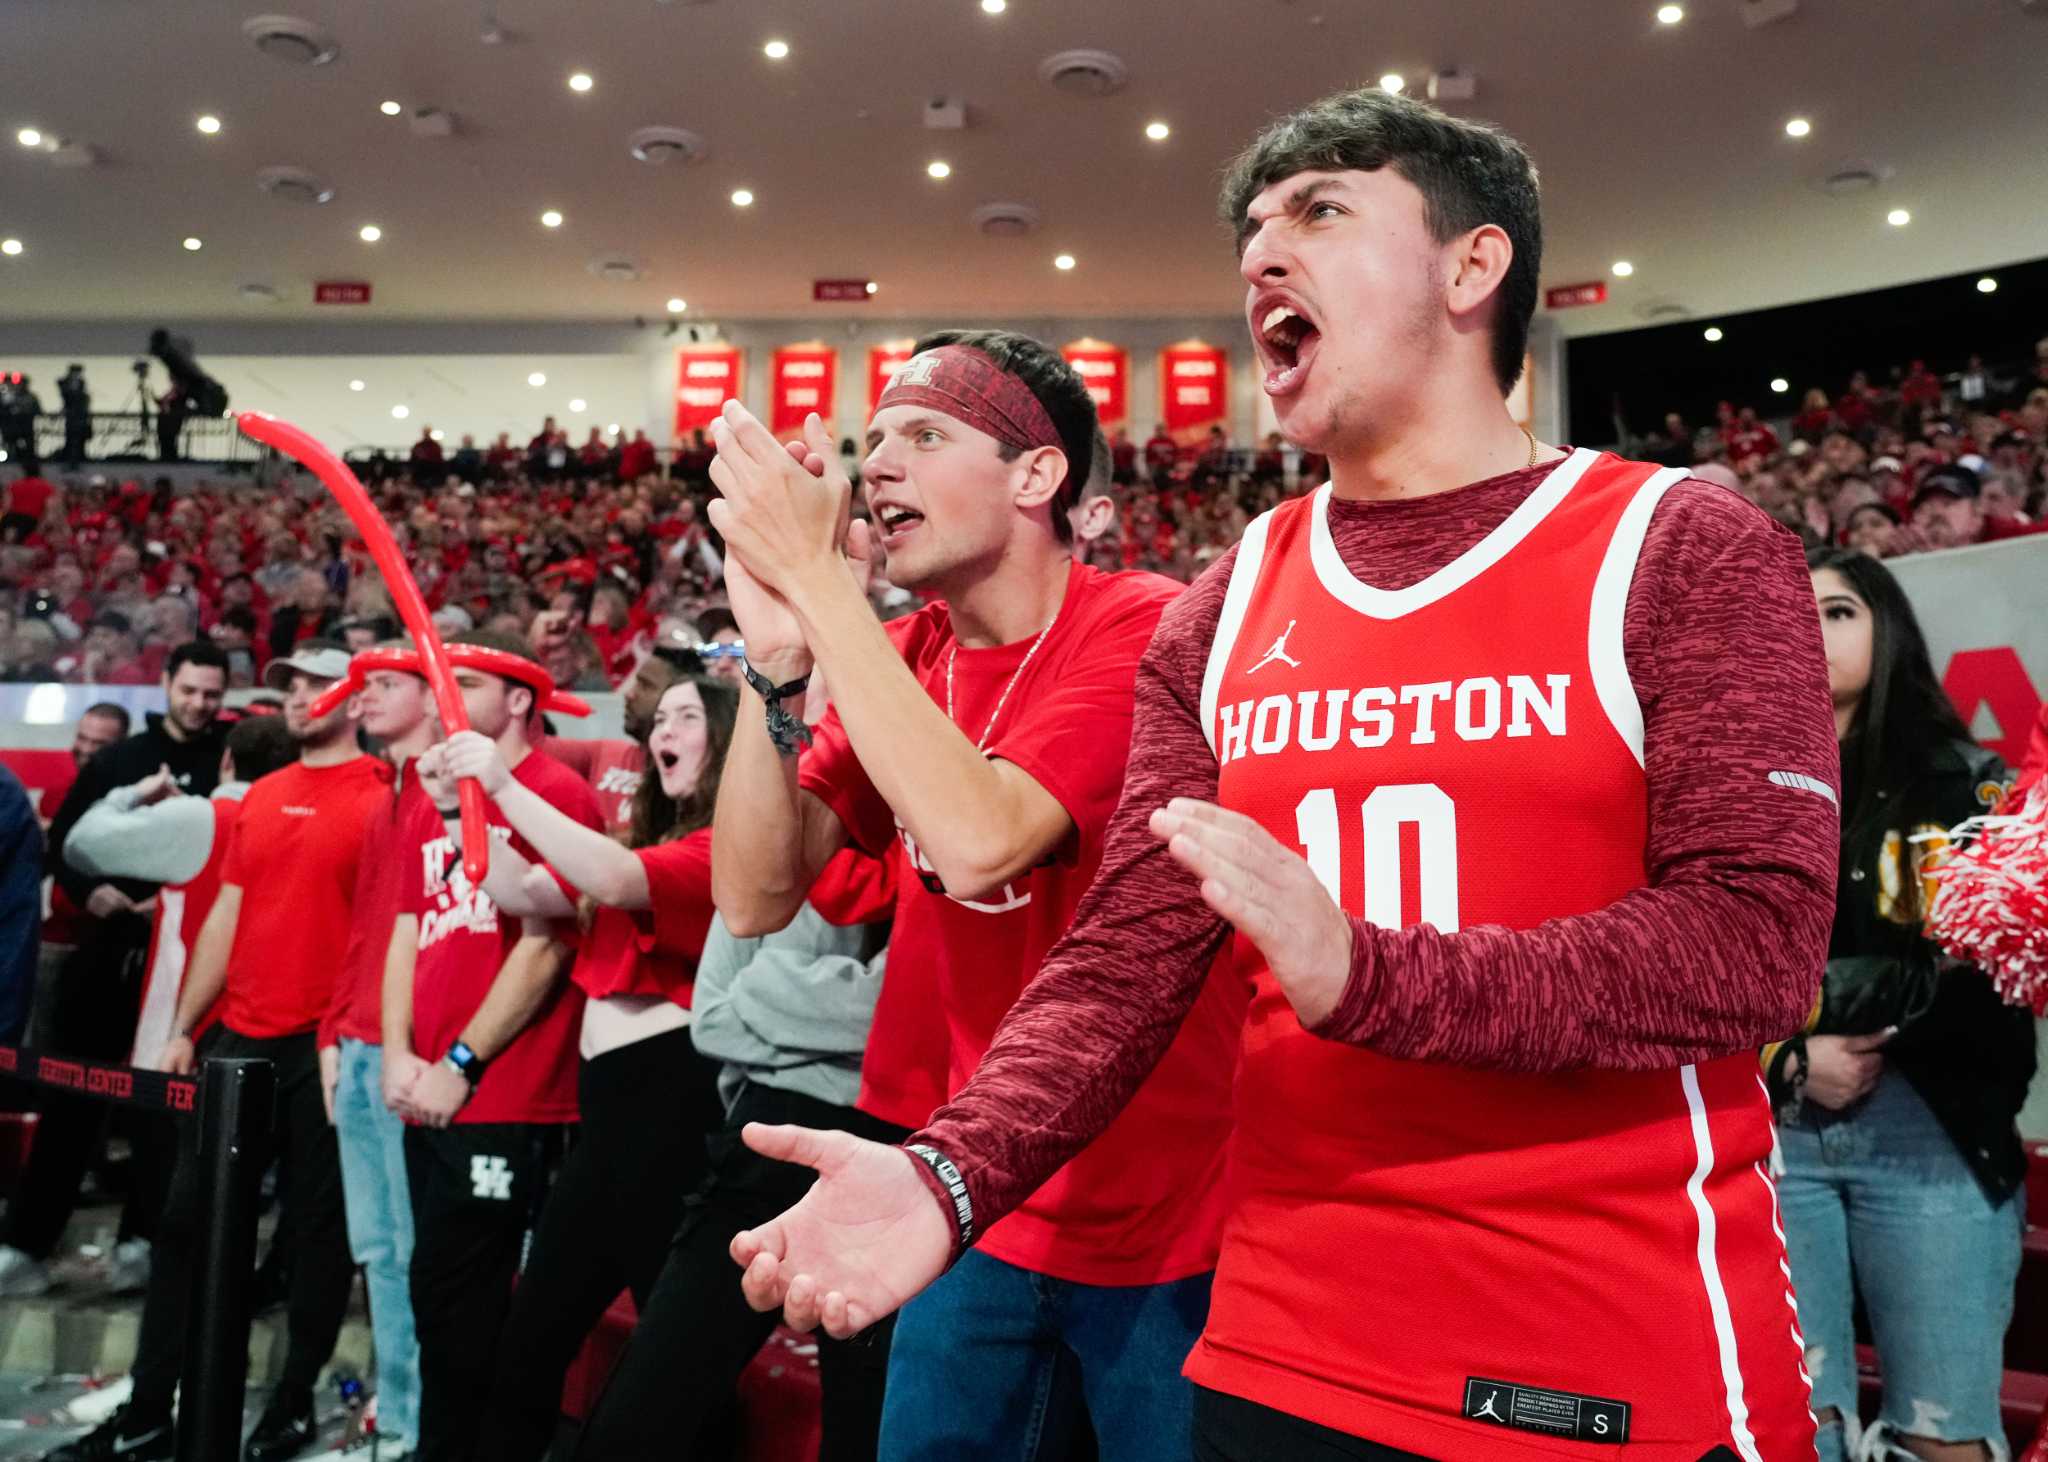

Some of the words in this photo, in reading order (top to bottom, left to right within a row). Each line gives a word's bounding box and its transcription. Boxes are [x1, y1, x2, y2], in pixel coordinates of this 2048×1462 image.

[1220, 674, 1571, 767] HOUSTON
[1295, 783, 1459, 936] 10
[1593, 1414, 1609, 1435] S
